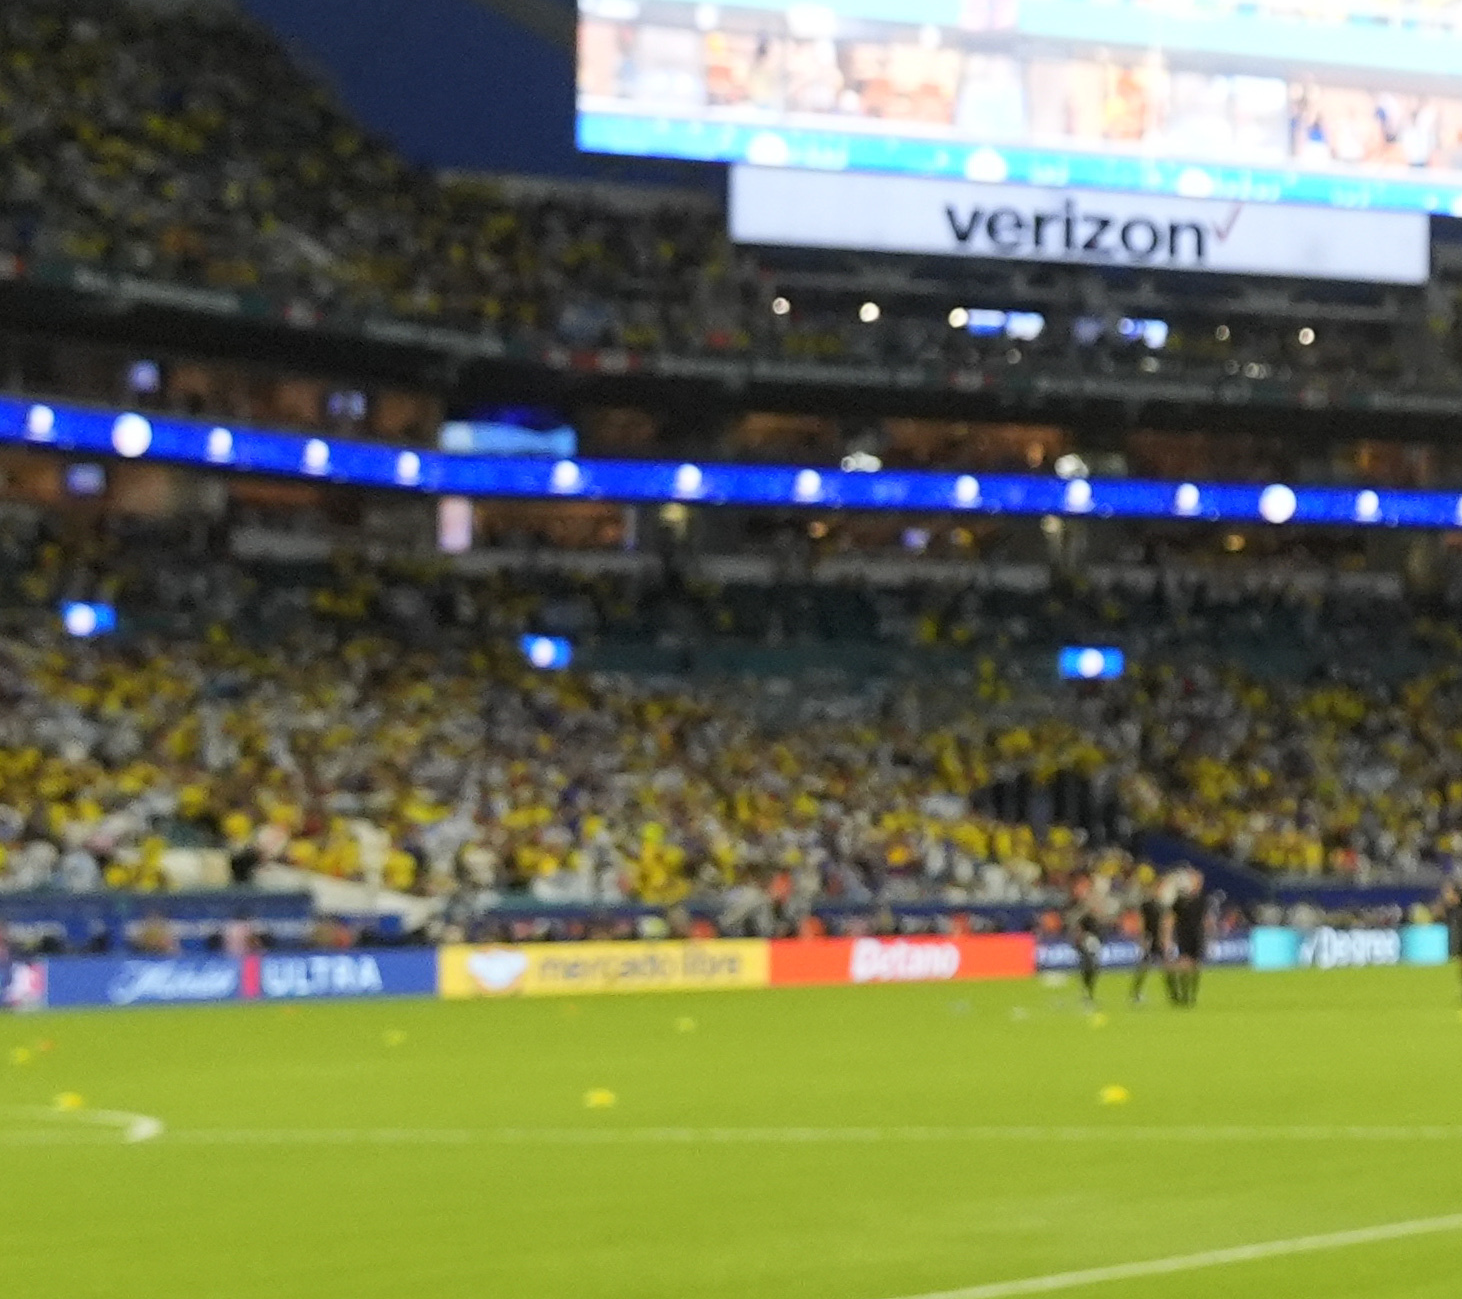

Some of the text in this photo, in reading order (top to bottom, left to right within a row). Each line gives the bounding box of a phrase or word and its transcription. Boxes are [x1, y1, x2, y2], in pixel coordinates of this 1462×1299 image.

[945, 199, 1204, 258] verizon
[262, 954, 384, 997] ULTRA
[537, 948, 743, 985] mercado libre
[850, 936, 961, 983] Betano
